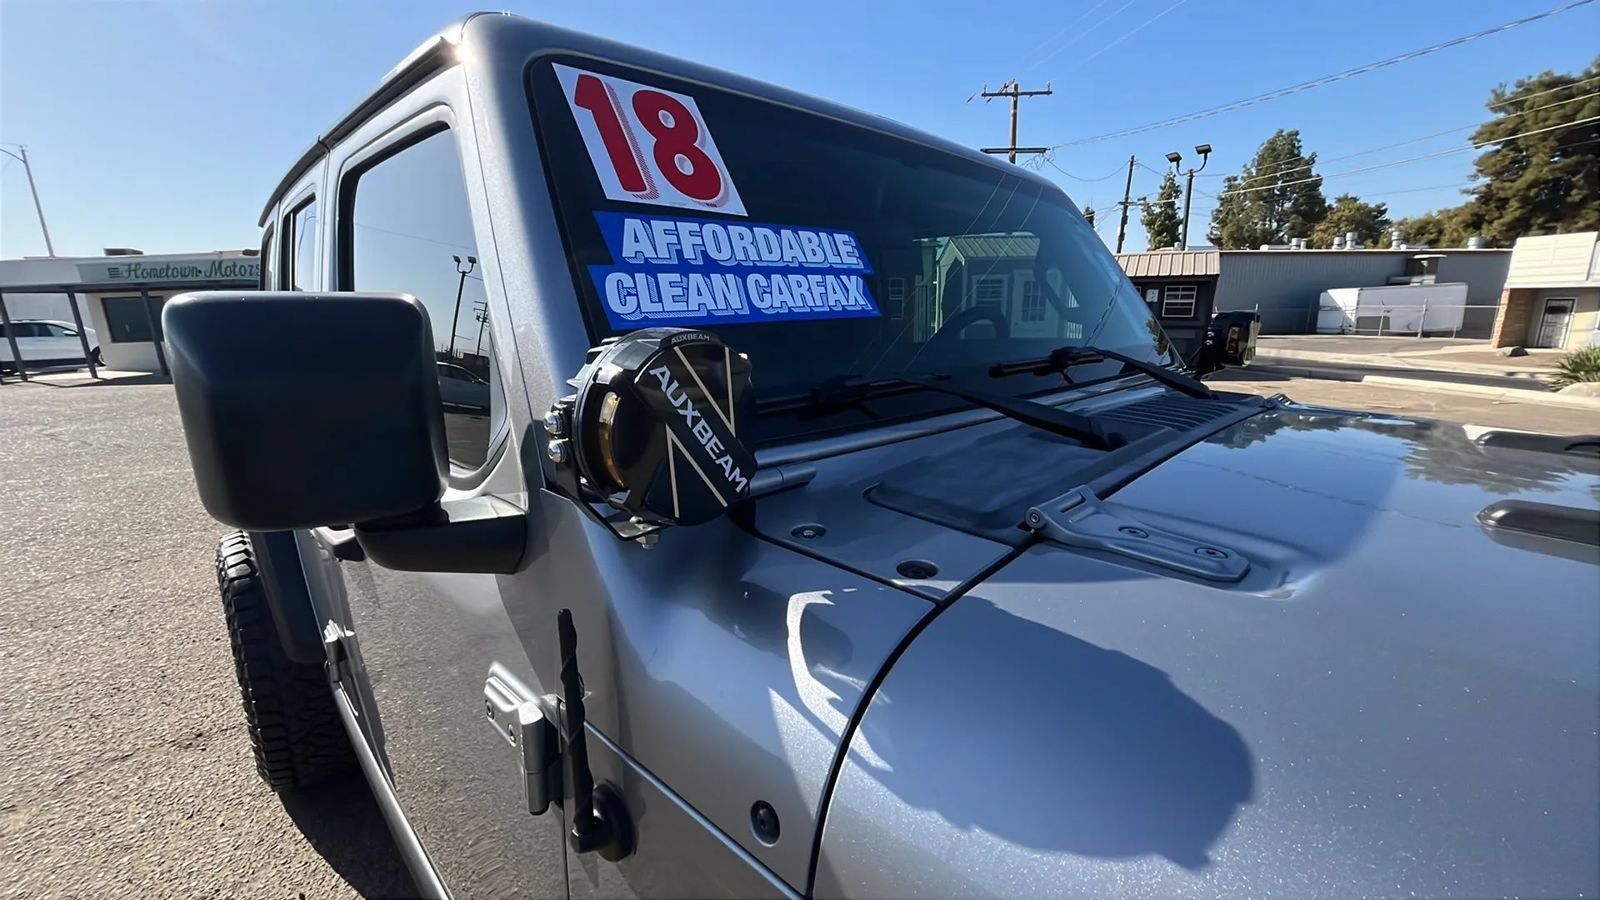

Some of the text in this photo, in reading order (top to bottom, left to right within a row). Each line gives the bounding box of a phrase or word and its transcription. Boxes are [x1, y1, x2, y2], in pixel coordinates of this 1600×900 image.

[574, 74, 725, 205] 18
[622, 218, 863, 268] AFFORDABLE
[122, 263, 198, 279] Hometown
[605, 272, 872, 319] CLEAN CARFAX
[671, 333, 710, 344] AUXBEAM
[649, 365, 748, 493] AUXBEAM
